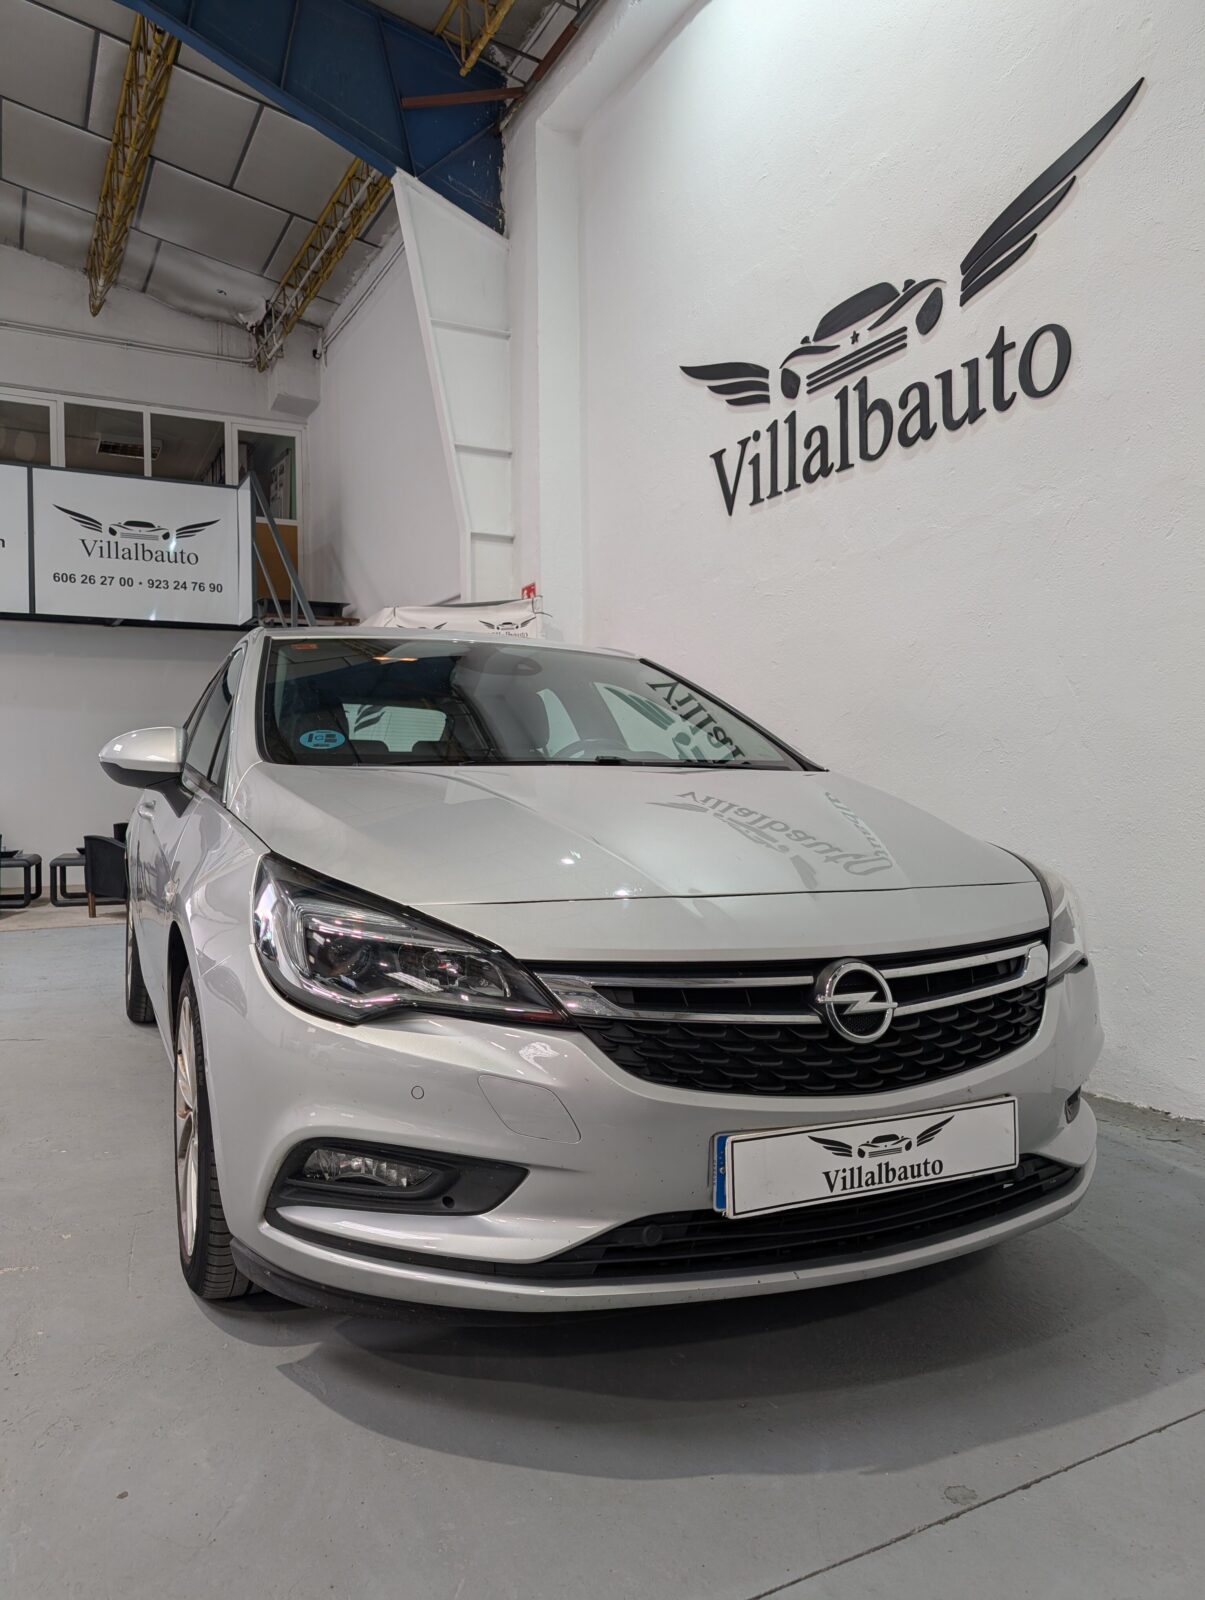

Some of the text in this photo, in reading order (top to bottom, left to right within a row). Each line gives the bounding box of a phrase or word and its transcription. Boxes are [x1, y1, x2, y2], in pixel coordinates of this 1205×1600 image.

[709, 323, 1072, 517] Villalbauto
[79, 538, 199, 566] Villalbauto
[52, 572, 223, 594] 606 26 27 00 923 24 76 90
[822, 1158, 944, 1193] Villalbauto
